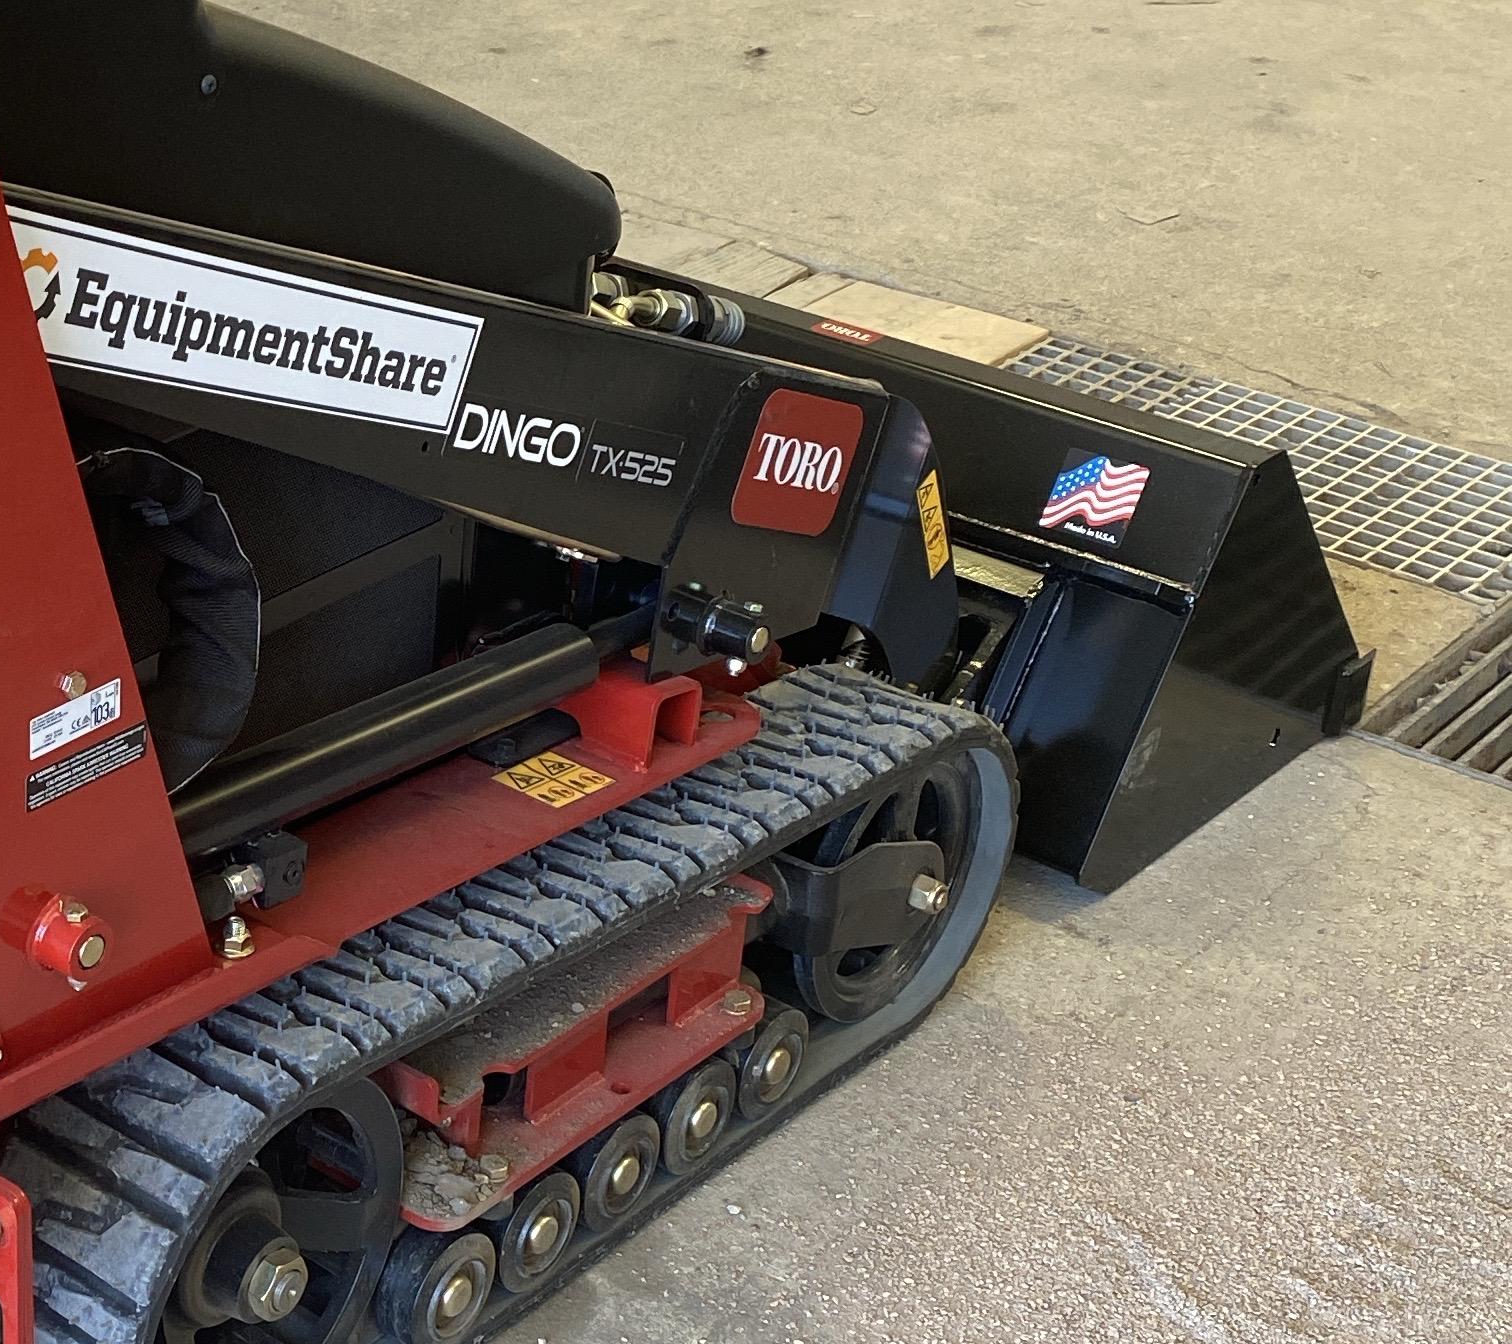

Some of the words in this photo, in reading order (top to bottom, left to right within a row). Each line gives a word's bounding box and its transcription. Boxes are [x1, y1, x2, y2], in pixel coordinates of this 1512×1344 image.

[64, 268, 448, 397] EquipmentShare
[453, 402, 582, 468] DINGO
[752, 431, 843, 494] TORO
